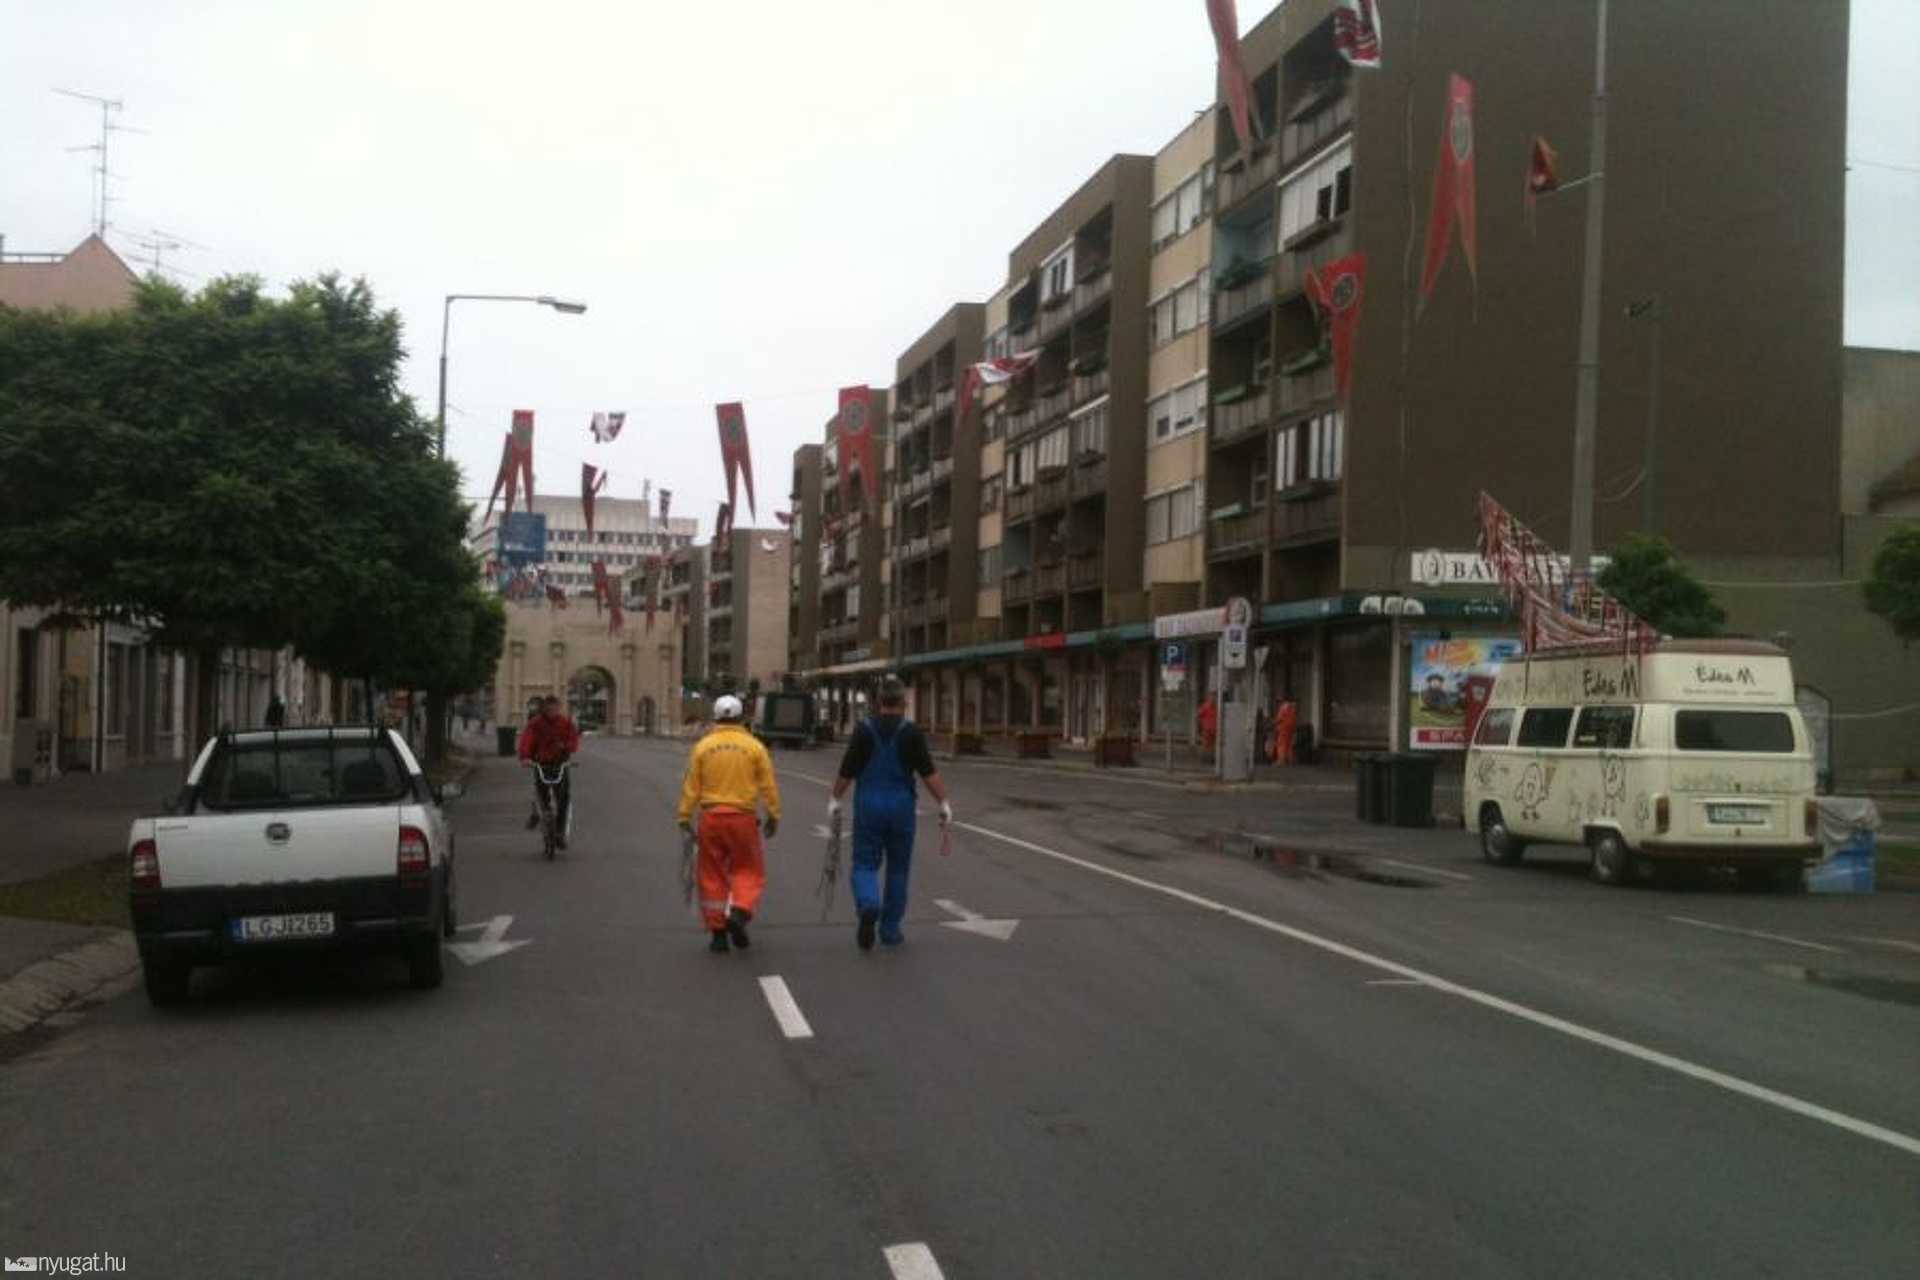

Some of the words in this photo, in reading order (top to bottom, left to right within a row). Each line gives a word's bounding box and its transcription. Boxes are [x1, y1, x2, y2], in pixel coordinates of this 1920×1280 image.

[1167, 645, 1179, 661] P
[1620, 664, 1639, 697] M
[1736, 666, 1757, 686] M
